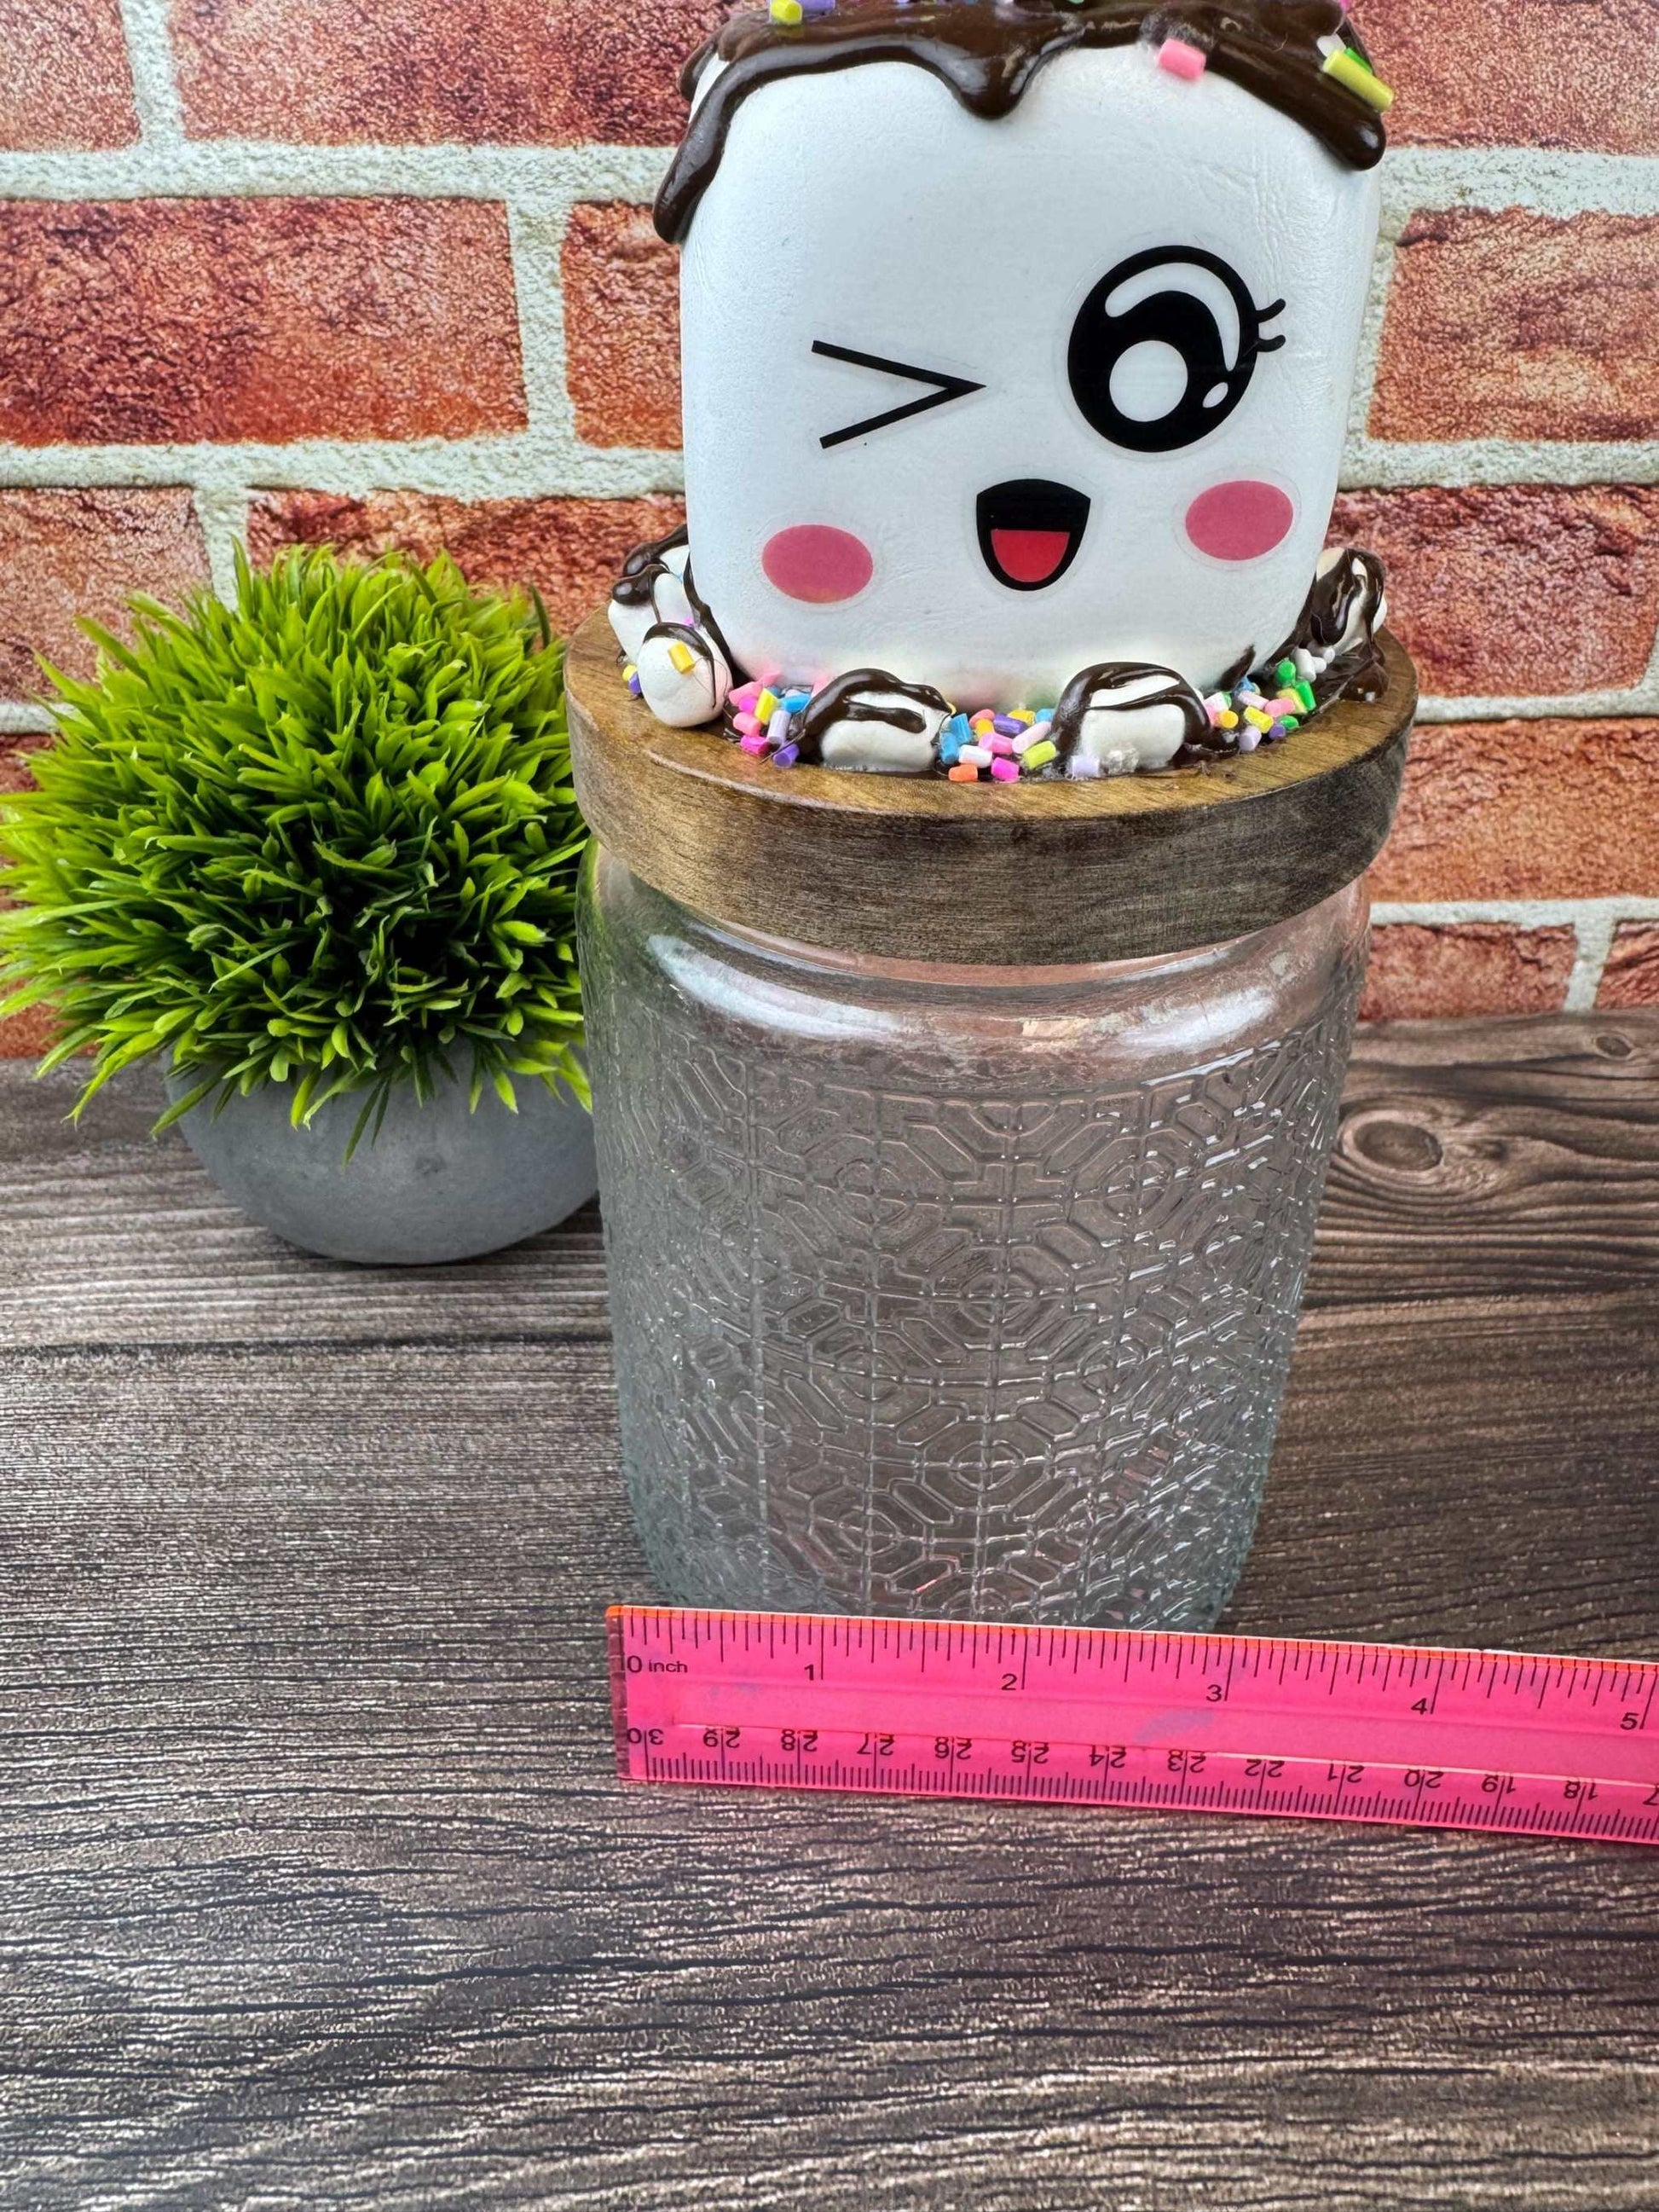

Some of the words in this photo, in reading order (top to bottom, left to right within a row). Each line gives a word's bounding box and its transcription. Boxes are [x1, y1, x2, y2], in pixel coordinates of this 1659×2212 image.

[627, 1655, 643, 1673] 0
[648, 1659, 688, 1673] inch
[804, 1664, 815, 1681] 1
[1001, 1673, 1018, 1690] 2
[1205, 1684, 1223, 1702] 3
[1411, 1698, 1428, 1715] 4
[1620, 1711, 1639, 1730] 5
[1404, 1769, 1444, 1788] 20
